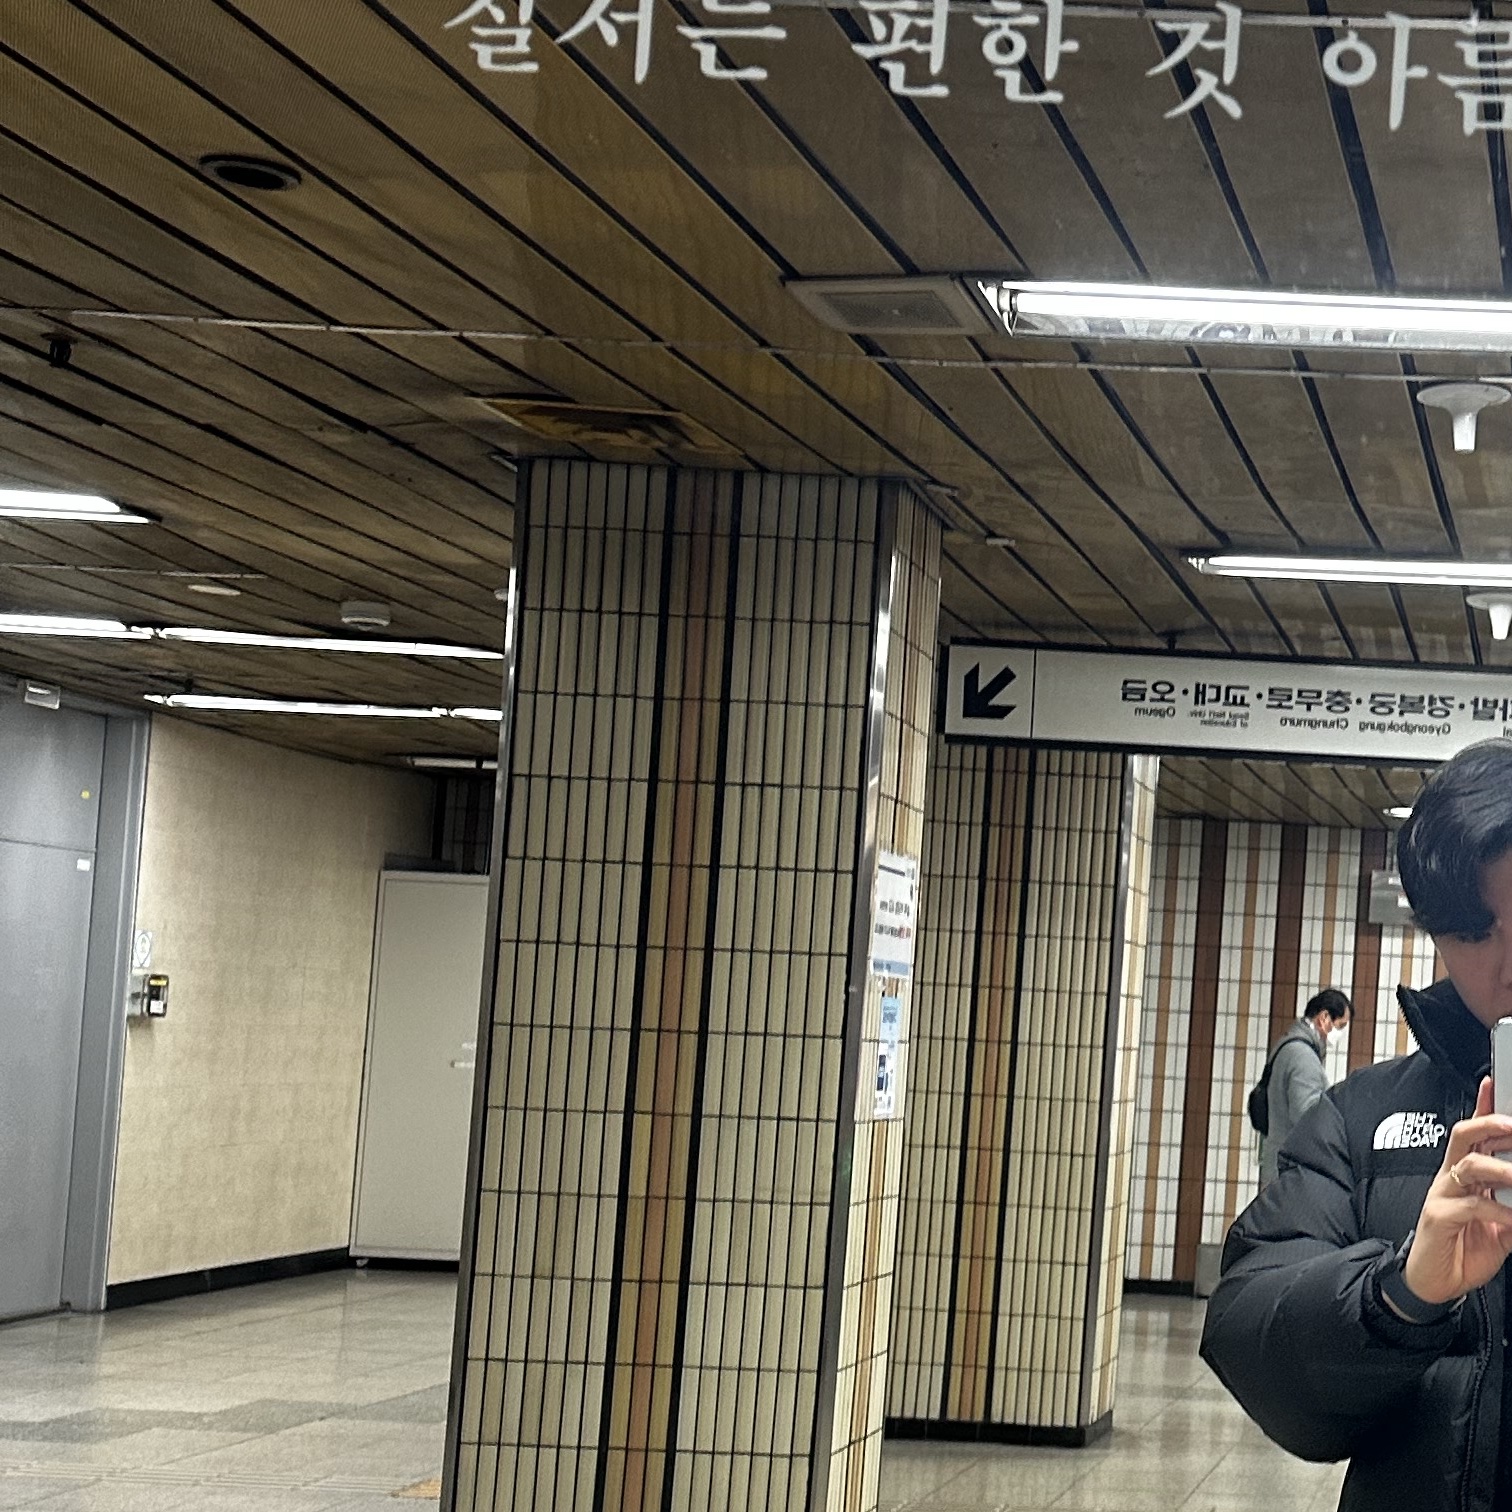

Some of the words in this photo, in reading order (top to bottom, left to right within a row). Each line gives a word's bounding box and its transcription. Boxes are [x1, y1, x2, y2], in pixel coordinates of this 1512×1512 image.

[443, 0, 786, 83] 질서는
[852, 0, 1079, 103] 편한
[1146, 3, 1242, 120] 것
